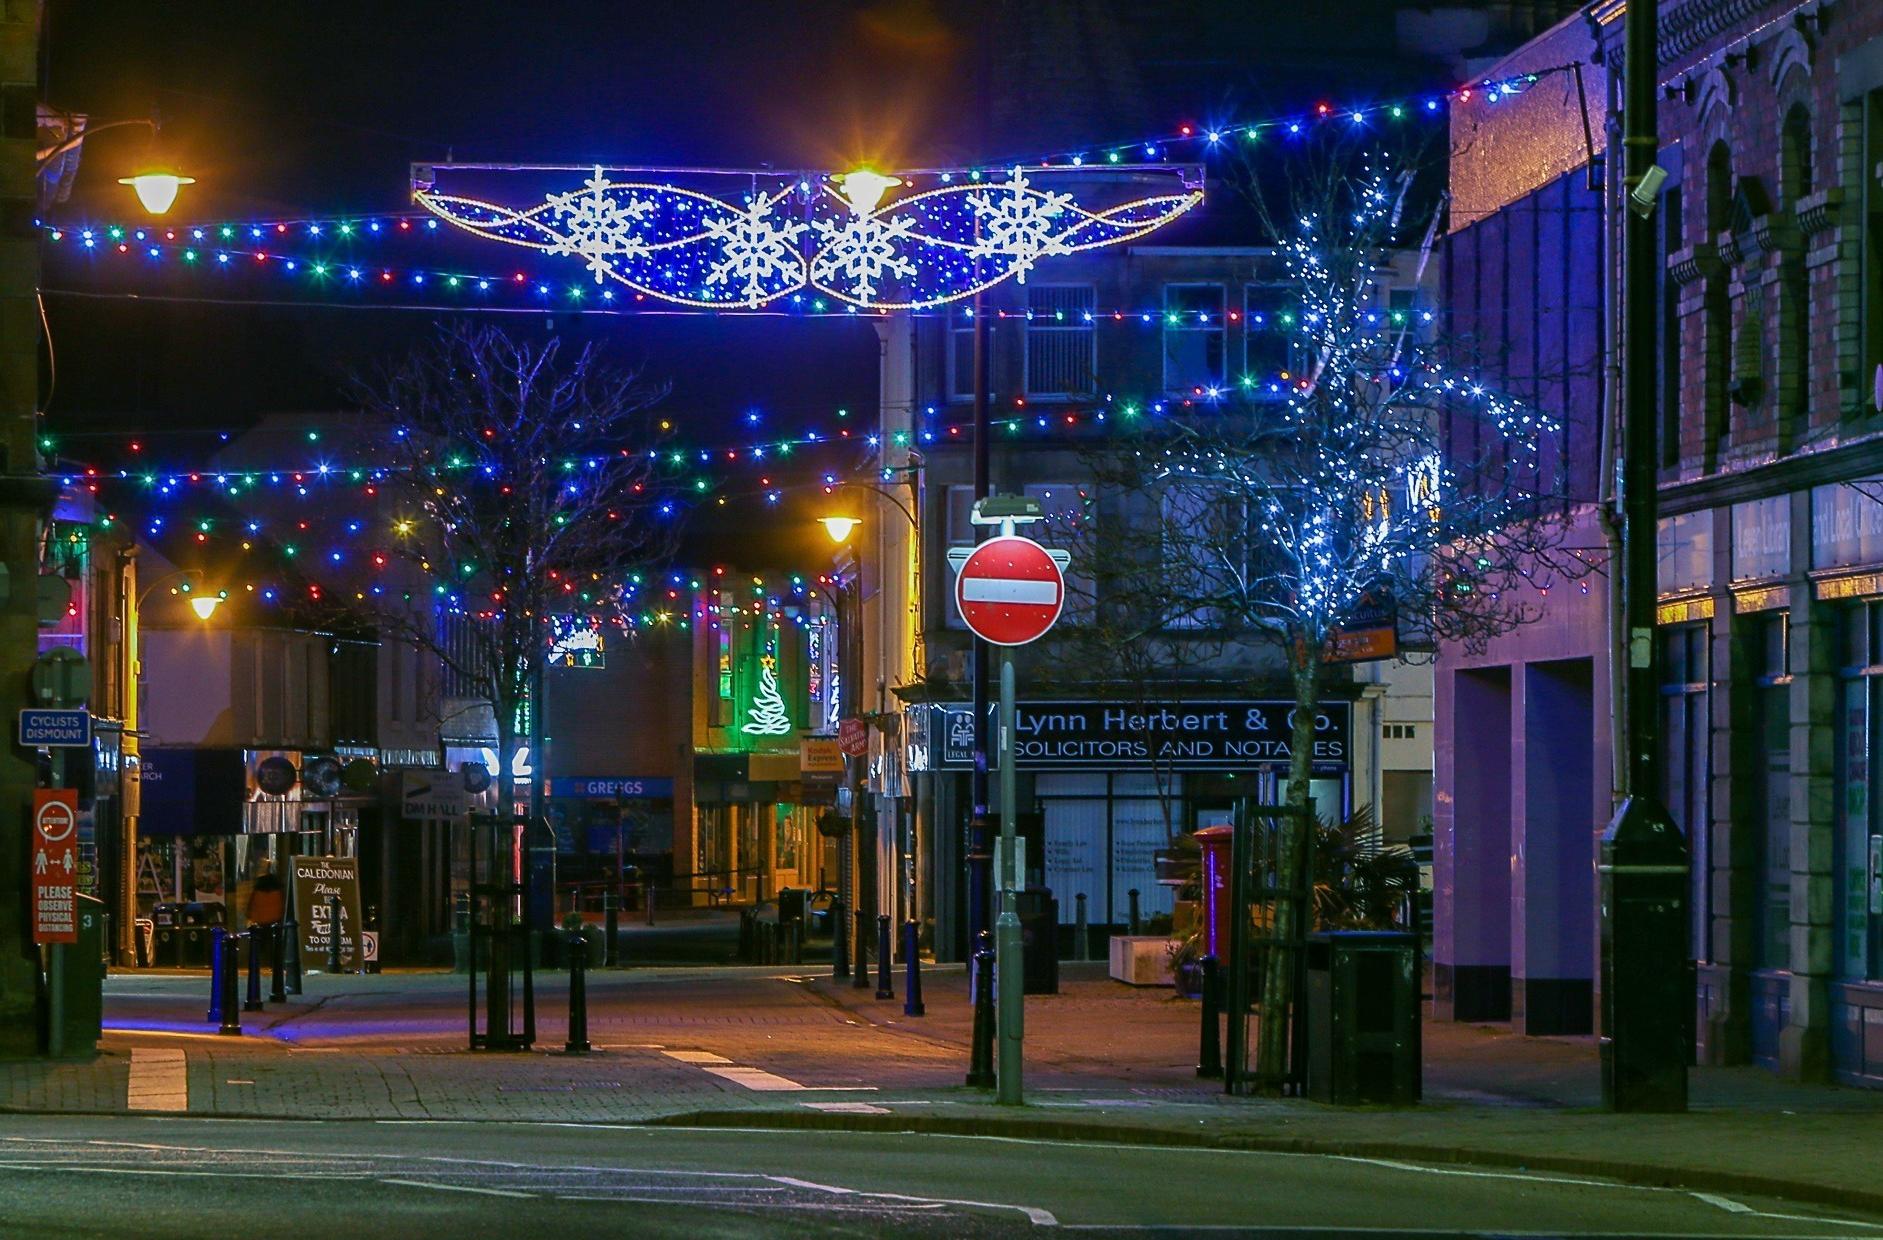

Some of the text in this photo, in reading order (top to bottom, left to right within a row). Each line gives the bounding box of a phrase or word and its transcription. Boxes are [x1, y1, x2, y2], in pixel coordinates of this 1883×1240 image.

[30, 716, 80, 727] CYCLISTS
[1016, 709, 1085, 734] Lynn
[1104, 709, 1227, 730] Herbert
[1246, 709, 1267, 730] &
[26, 728, 83, 739] DISMOUNT
[1015, 741, 1343, 756] SOLICITORS AND NOTAES
[588, 781, 643, 794] GREGGS
[297, 868, 354, 880] CALEDONIAN
[38, 886, 73, 899] PLEASE
[313, 883, 341, 895] Please
[38, 900, 73, 911] OBSERVE
[38, 912, 73, 922] PHYSICAL
[312, 905, 348, 920] EXTA
[83, 914, 93, 928] 3
